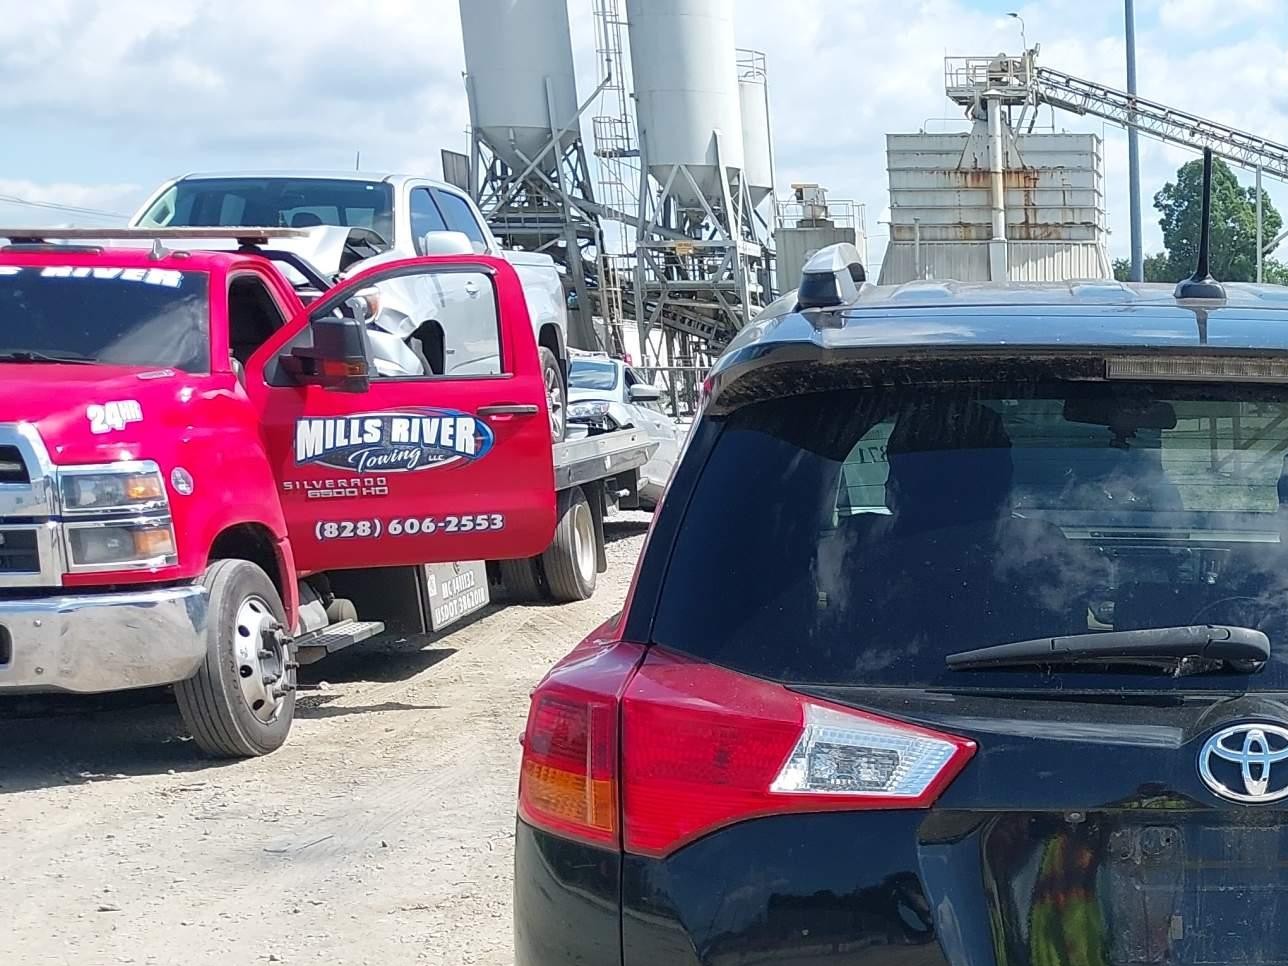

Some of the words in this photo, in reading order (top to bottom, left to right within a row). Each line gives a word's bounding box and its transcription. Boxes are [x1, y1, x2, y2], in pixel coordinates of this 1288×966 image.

[296, 418, 382, 461] MILLS
[391, 417, 477, 455] RIVER
[348, 446, 422, 473] Towing
[428, 454, 445, 462] LLC
[283, 477, 387, 490] SILVERADO
[307, 487, 358, 499] 6500
[362, 486, 389, 496] HD
[315, 519, 381, 540] (828)
[388, 514, 504, 535] 606-2553
